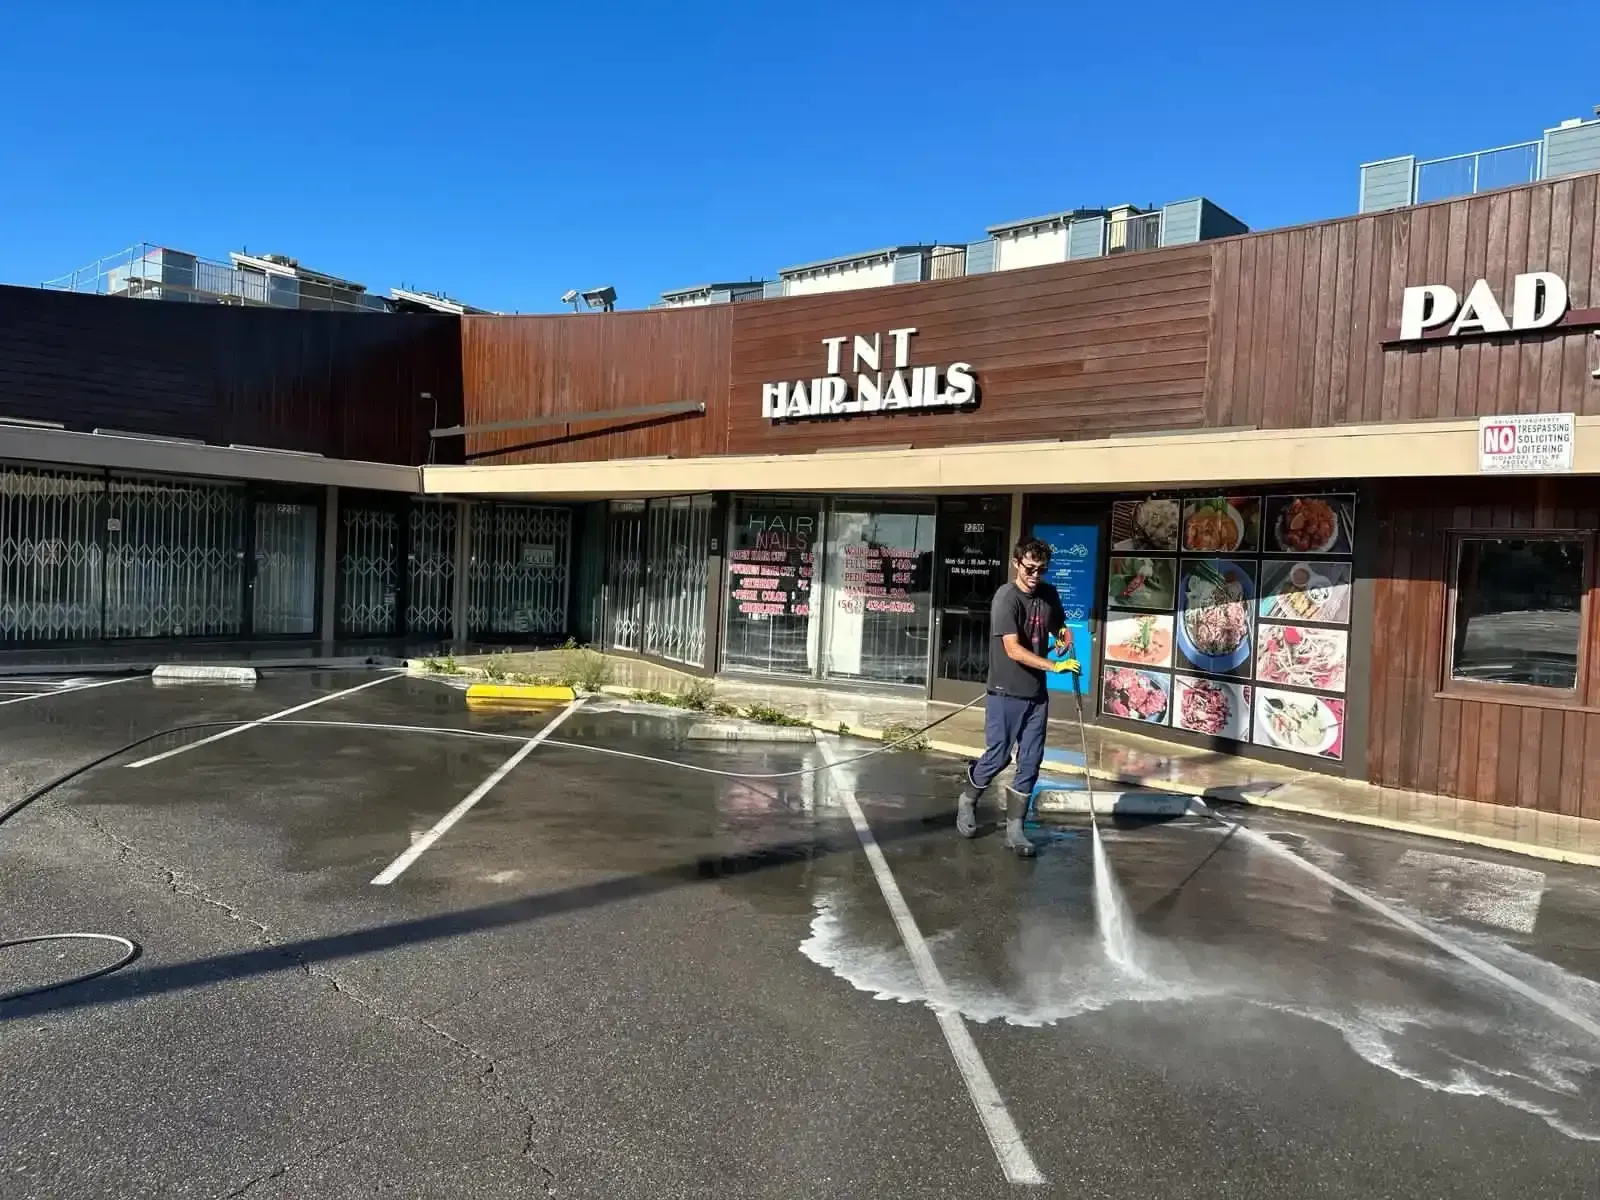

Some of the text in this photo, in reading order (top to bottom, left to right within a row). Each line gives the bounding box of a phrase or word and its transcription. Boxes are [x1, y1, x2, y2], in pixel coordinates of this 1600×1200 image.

[1400, 272, 1567, 339] PAD
[821, 328, 917, 374] TNT
[762, 362, 976, 418] HAIR NAILS
[1518, 424, 1569, 433] TRESPASSING
[1518, 434, 1569, 443] SOLICITING
[1485, 427, 1514, 453] NO
[1517, 445, 1563, 453] LOITERING
[749, 514, 814, 533] HAIR
[756, 530, 808, 552] NAILS
